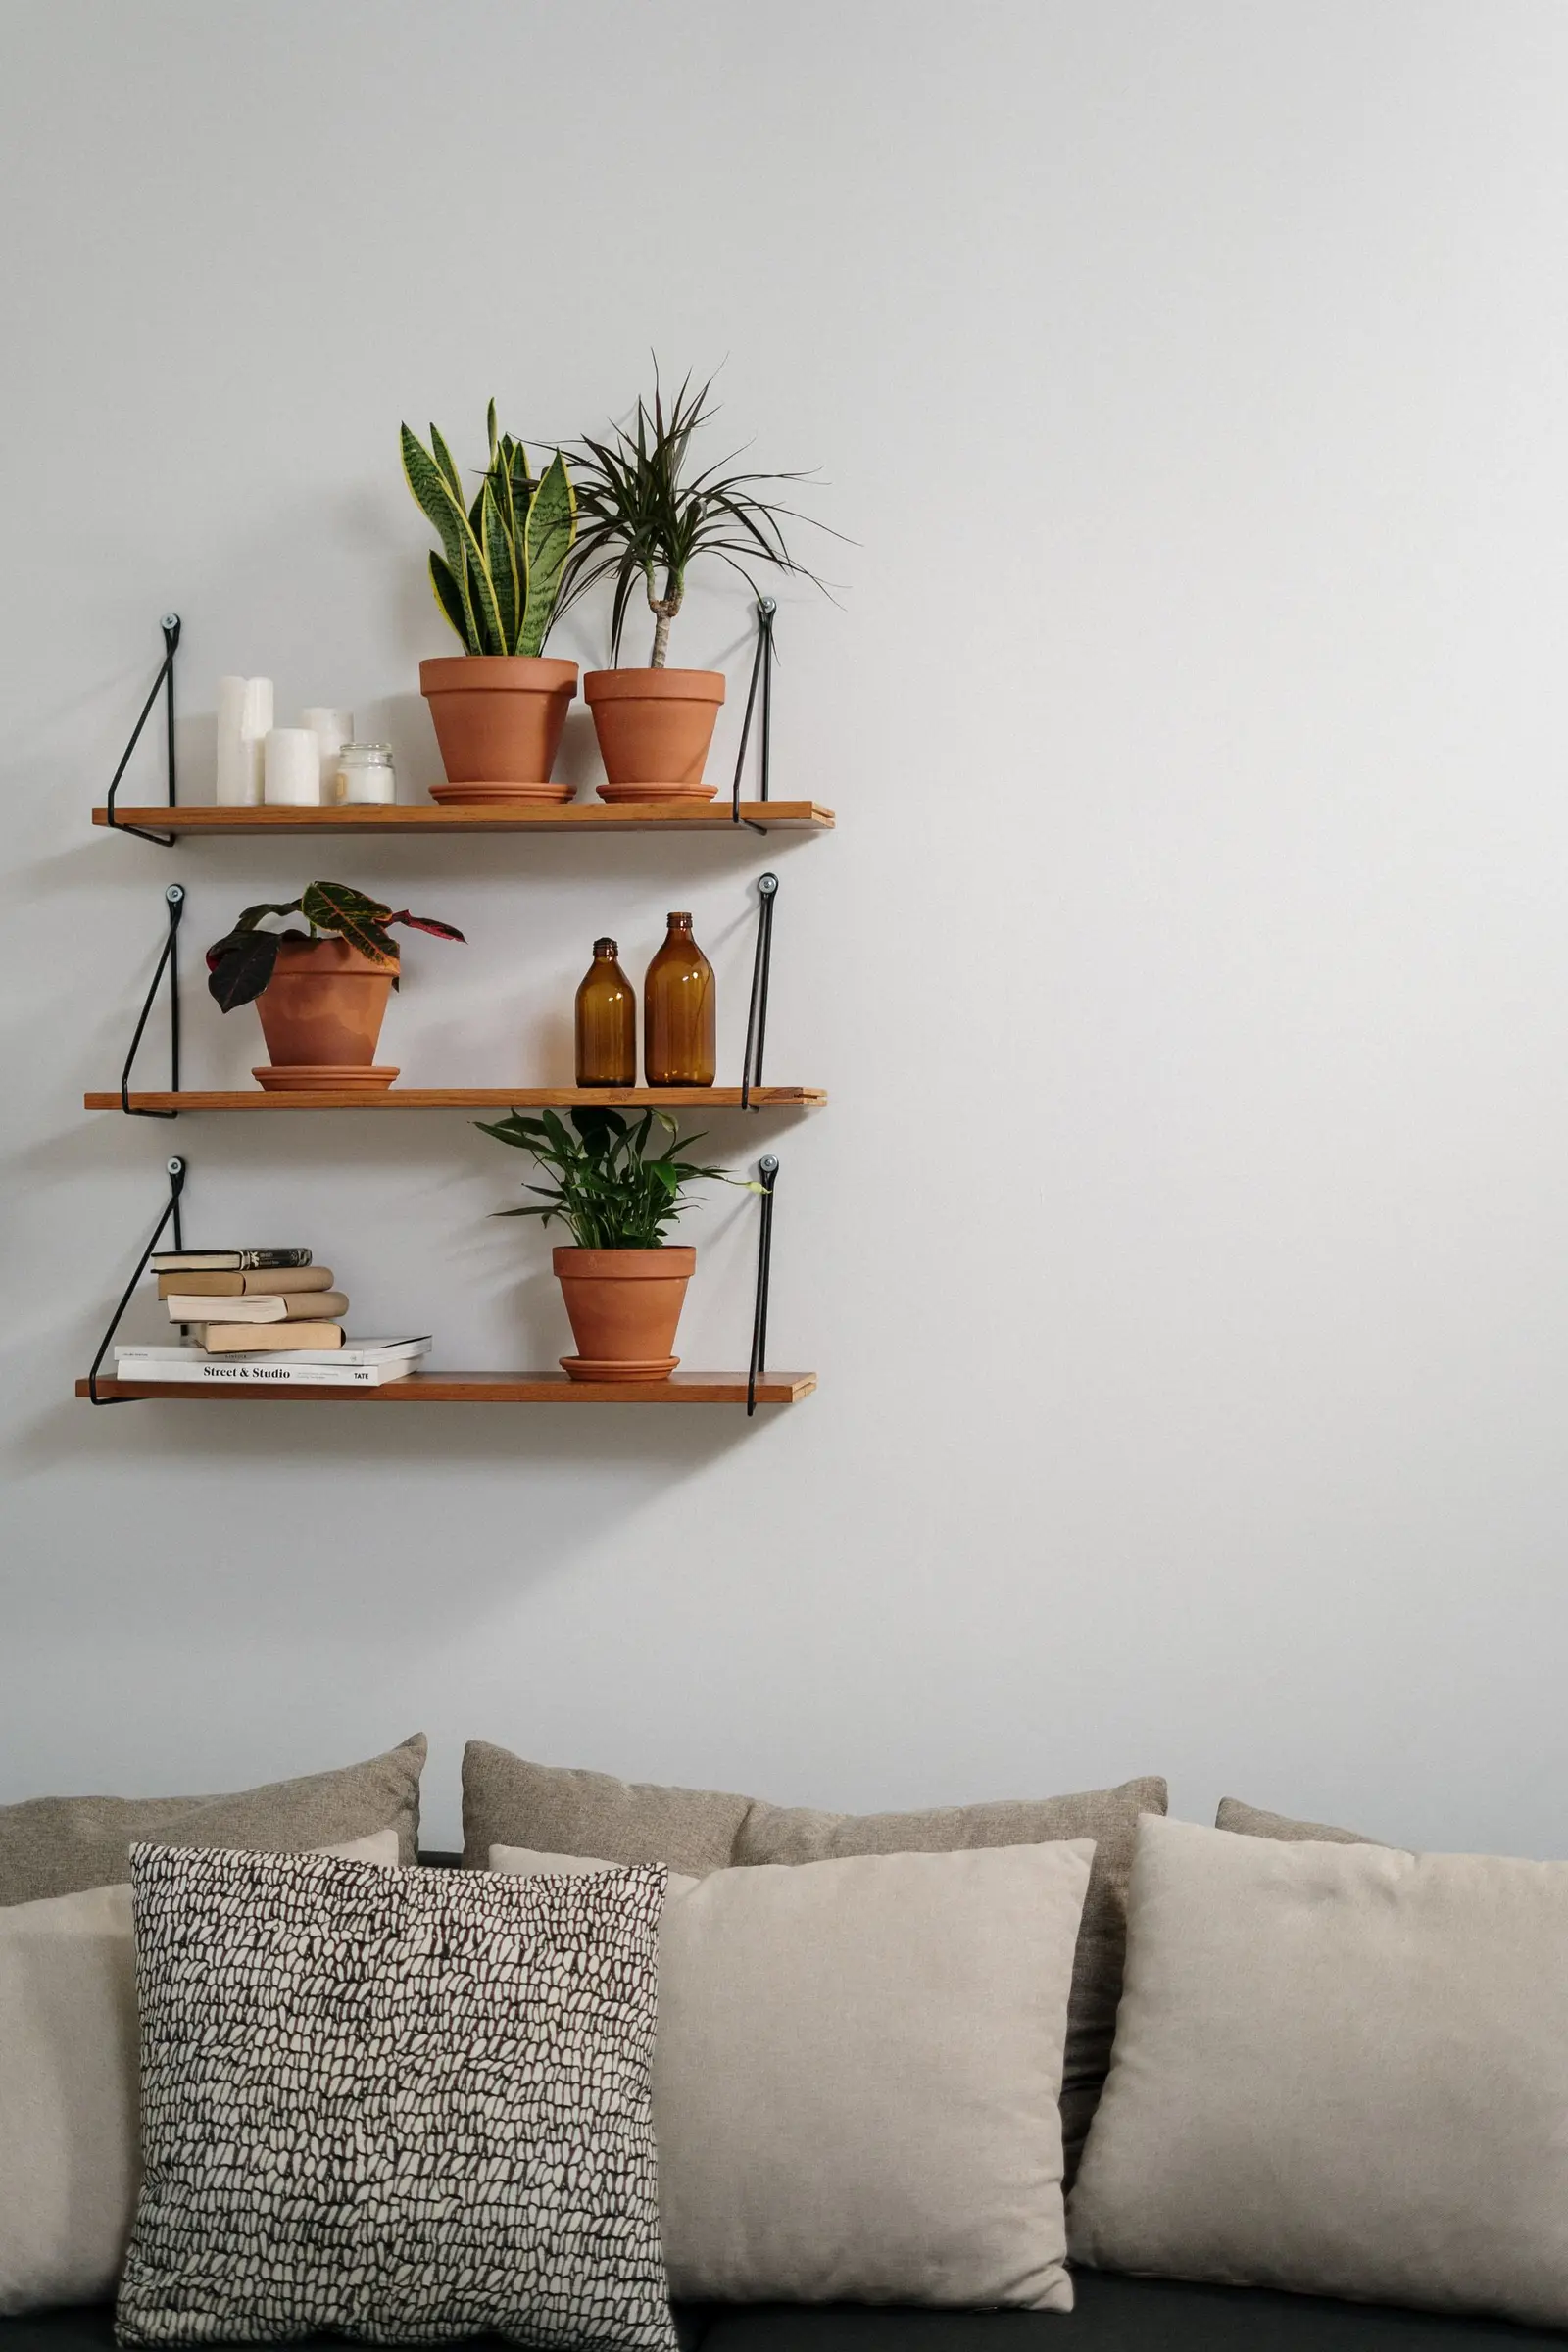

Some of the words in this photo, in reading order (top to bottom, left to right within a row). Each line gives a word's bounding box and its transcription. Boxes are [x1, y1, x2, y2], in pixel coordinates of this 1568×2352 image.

[204, 1366, 237, 1377] Street
[240, 1368, 250, 1378] &
[252, 1368, 291, 1380] Studio
